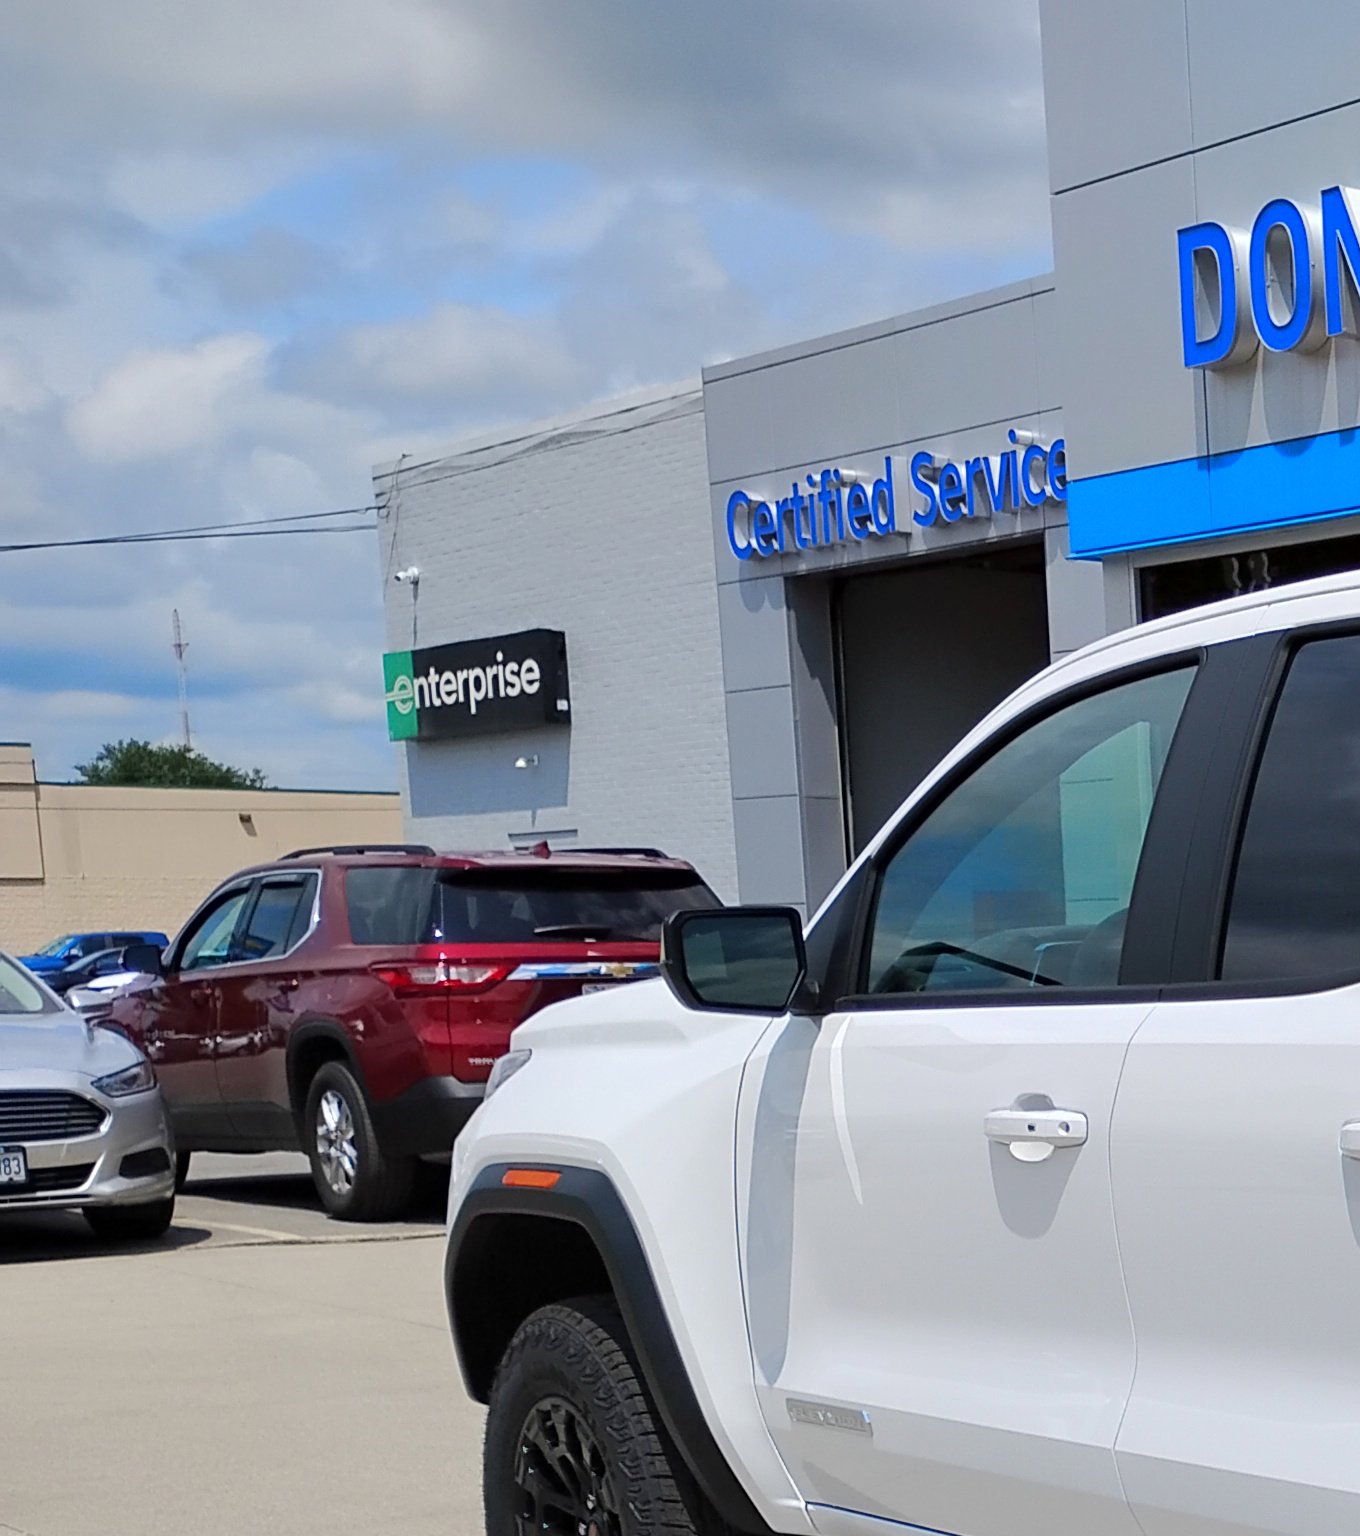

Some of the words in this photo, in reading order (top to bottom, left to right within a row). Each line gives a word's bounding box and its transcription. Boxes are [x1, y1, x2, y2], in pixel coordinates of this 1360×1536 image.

[727, 456, 897, 560] Certified
[385, 651, 541, 715] enterprise
[0, 1156, 21, 1176] 83
